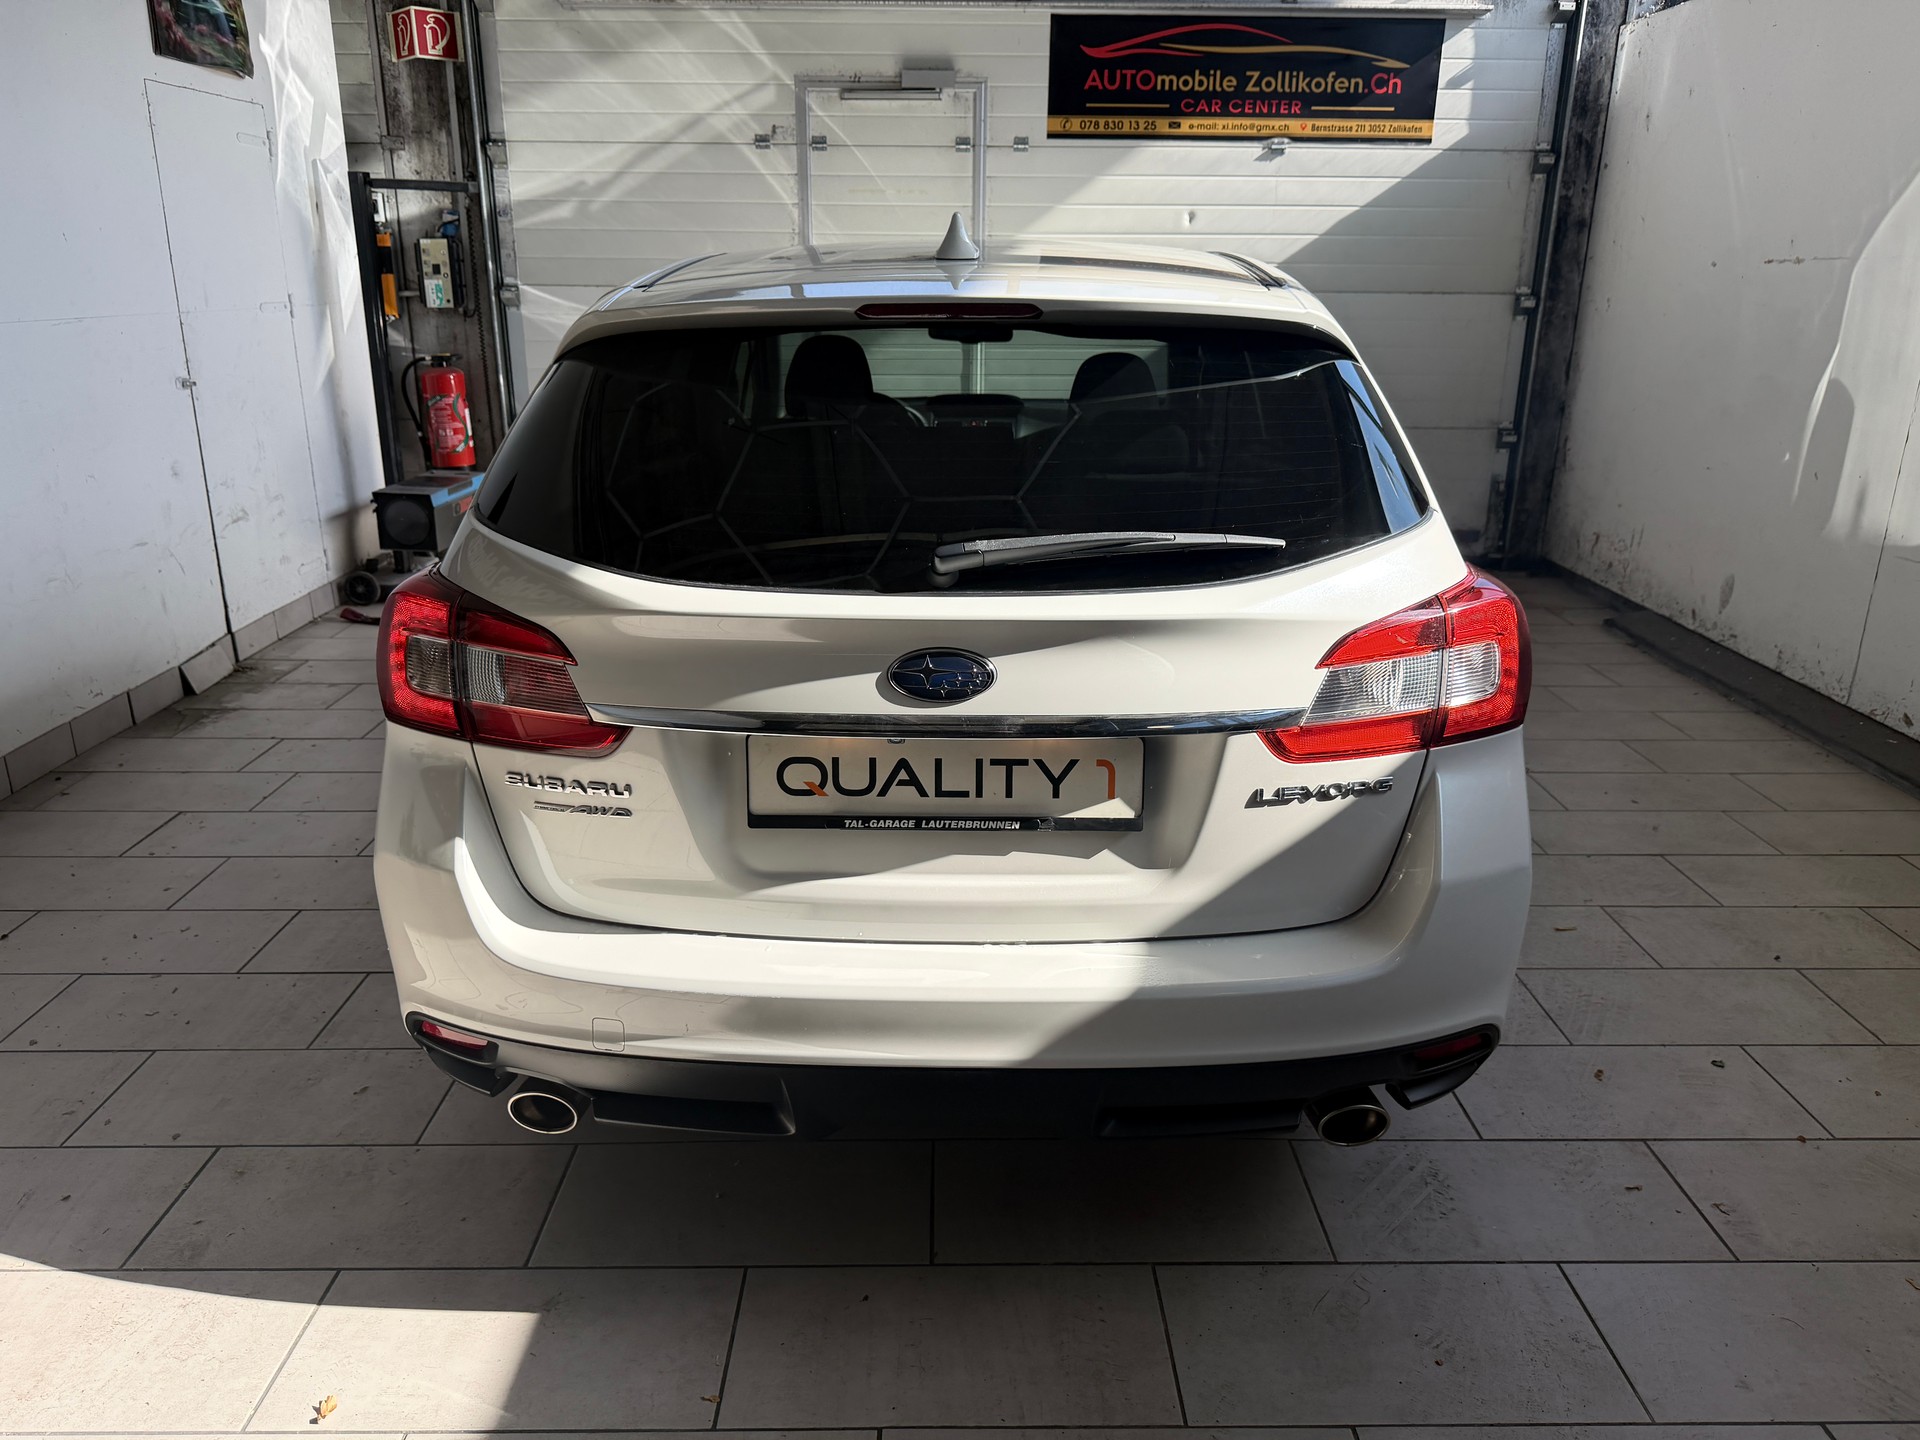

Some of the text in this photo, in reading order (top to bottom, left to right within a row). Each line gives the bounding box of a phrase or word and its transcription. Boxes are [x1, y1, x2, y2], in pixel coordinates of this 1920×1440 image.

[1084, 69, 1237, 92] AUTOmobile
[1181, 99, 1302, 114] CAR CENTER
[1079, 119, 1100, 130] 078
[1103, 120, 1124, 130] 830
[1128, 120, 1140, 130] 13
[1143, 120, 1157, 130] 25
[1311, 123, 1353, 132] Bernstrasse
[1355, 123, 1366, 132] 211
[1368, 124, 1386, 133] 3052
[1388, 124, 1423, 133] Zollikofen
[504, 770, 632, 799] SUBARU
[776, 756, 1116, 800] QUALITY 1
[1246, 776, 1394, 804] LEVORG
[569, 804, 632, 819] AWD
[844, 819, 1020, 829] TAL-GARAGE LAUTERBRUNNEN
